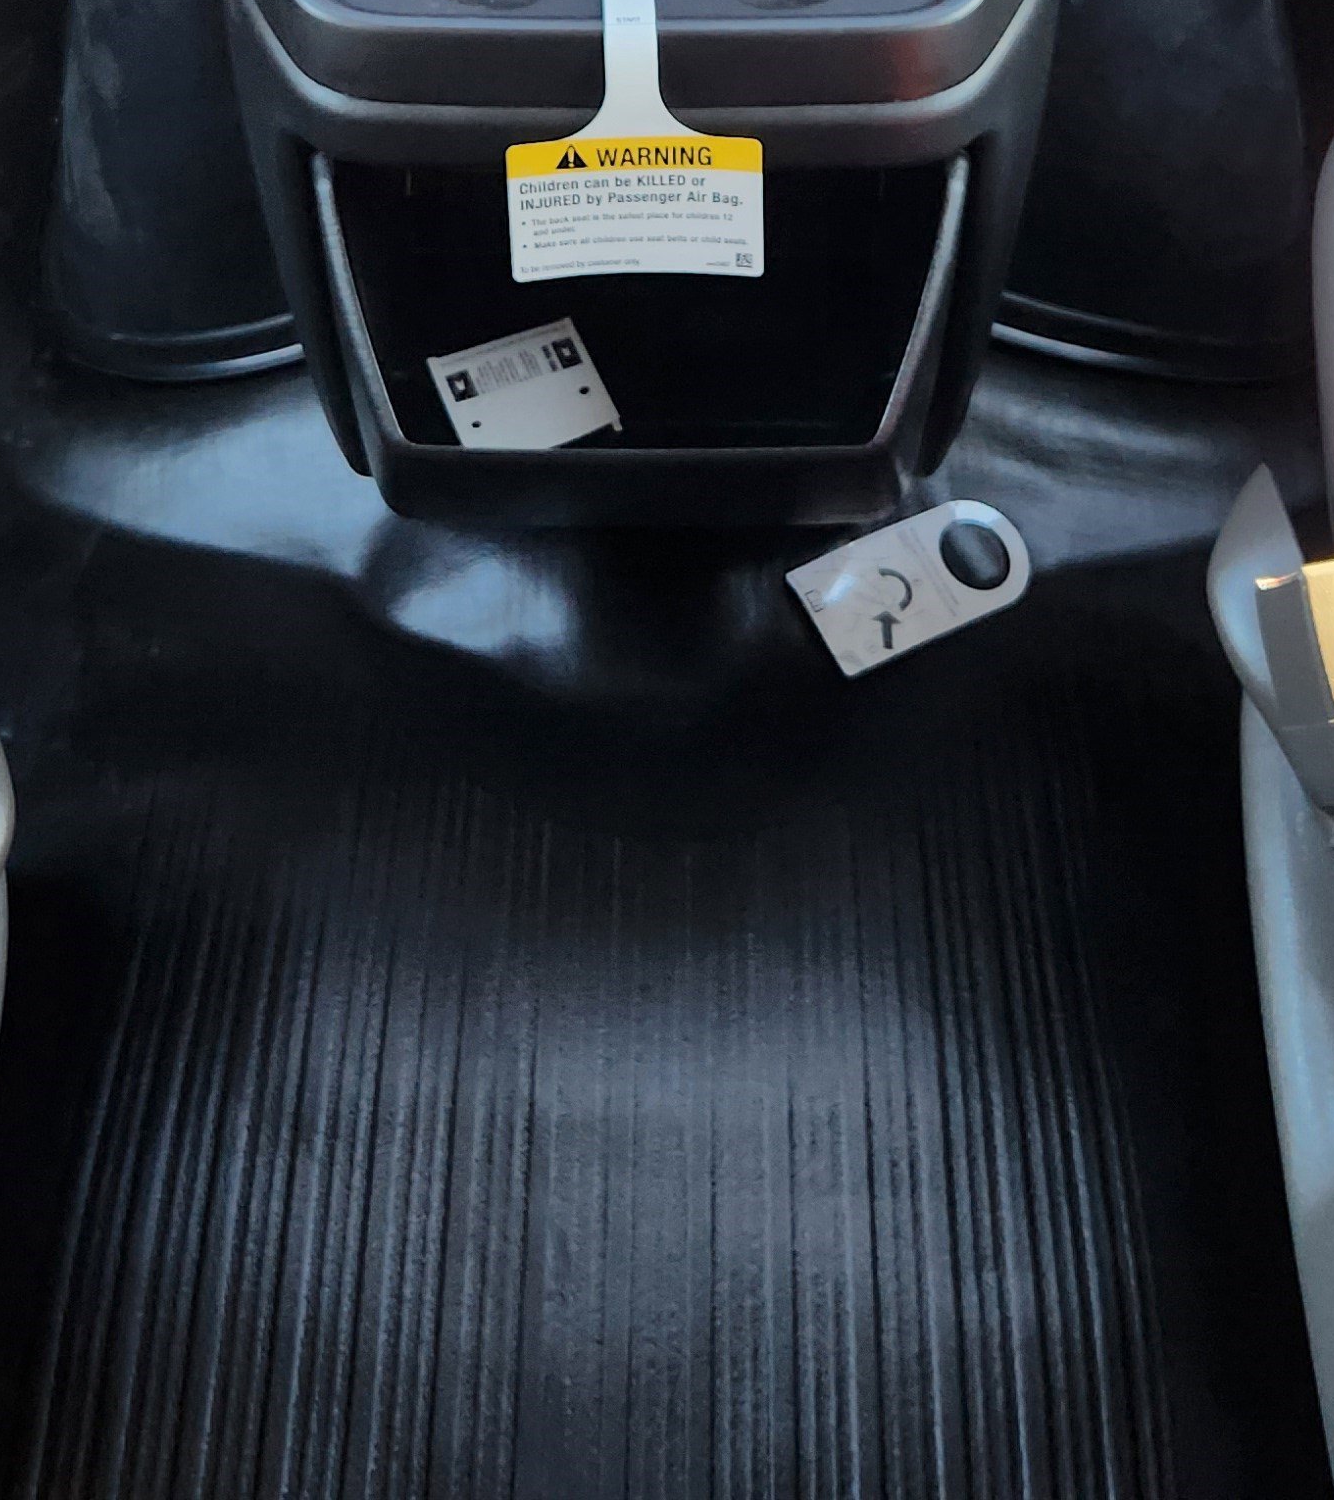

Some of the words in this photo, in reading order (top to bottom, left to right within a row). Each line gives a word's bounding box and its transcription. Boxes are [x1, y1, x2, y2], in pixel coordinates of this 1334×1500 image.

[596, 146, 712, 167] WARNING
[519, 180, 579, 194] Children
[584, 178, 609, 188] can
[615, 176, 631, 187] be
[637, 174, 686, 186] KILLED
[691, 177, 706, 186] or
[520, 193, 581, 210] INJURED
[586, 193, 602, 206] by
[608, 191, 681, 204] Passenger
[687, 191, 707, 202] Air
[712, 191, 743, 206] Bag.
